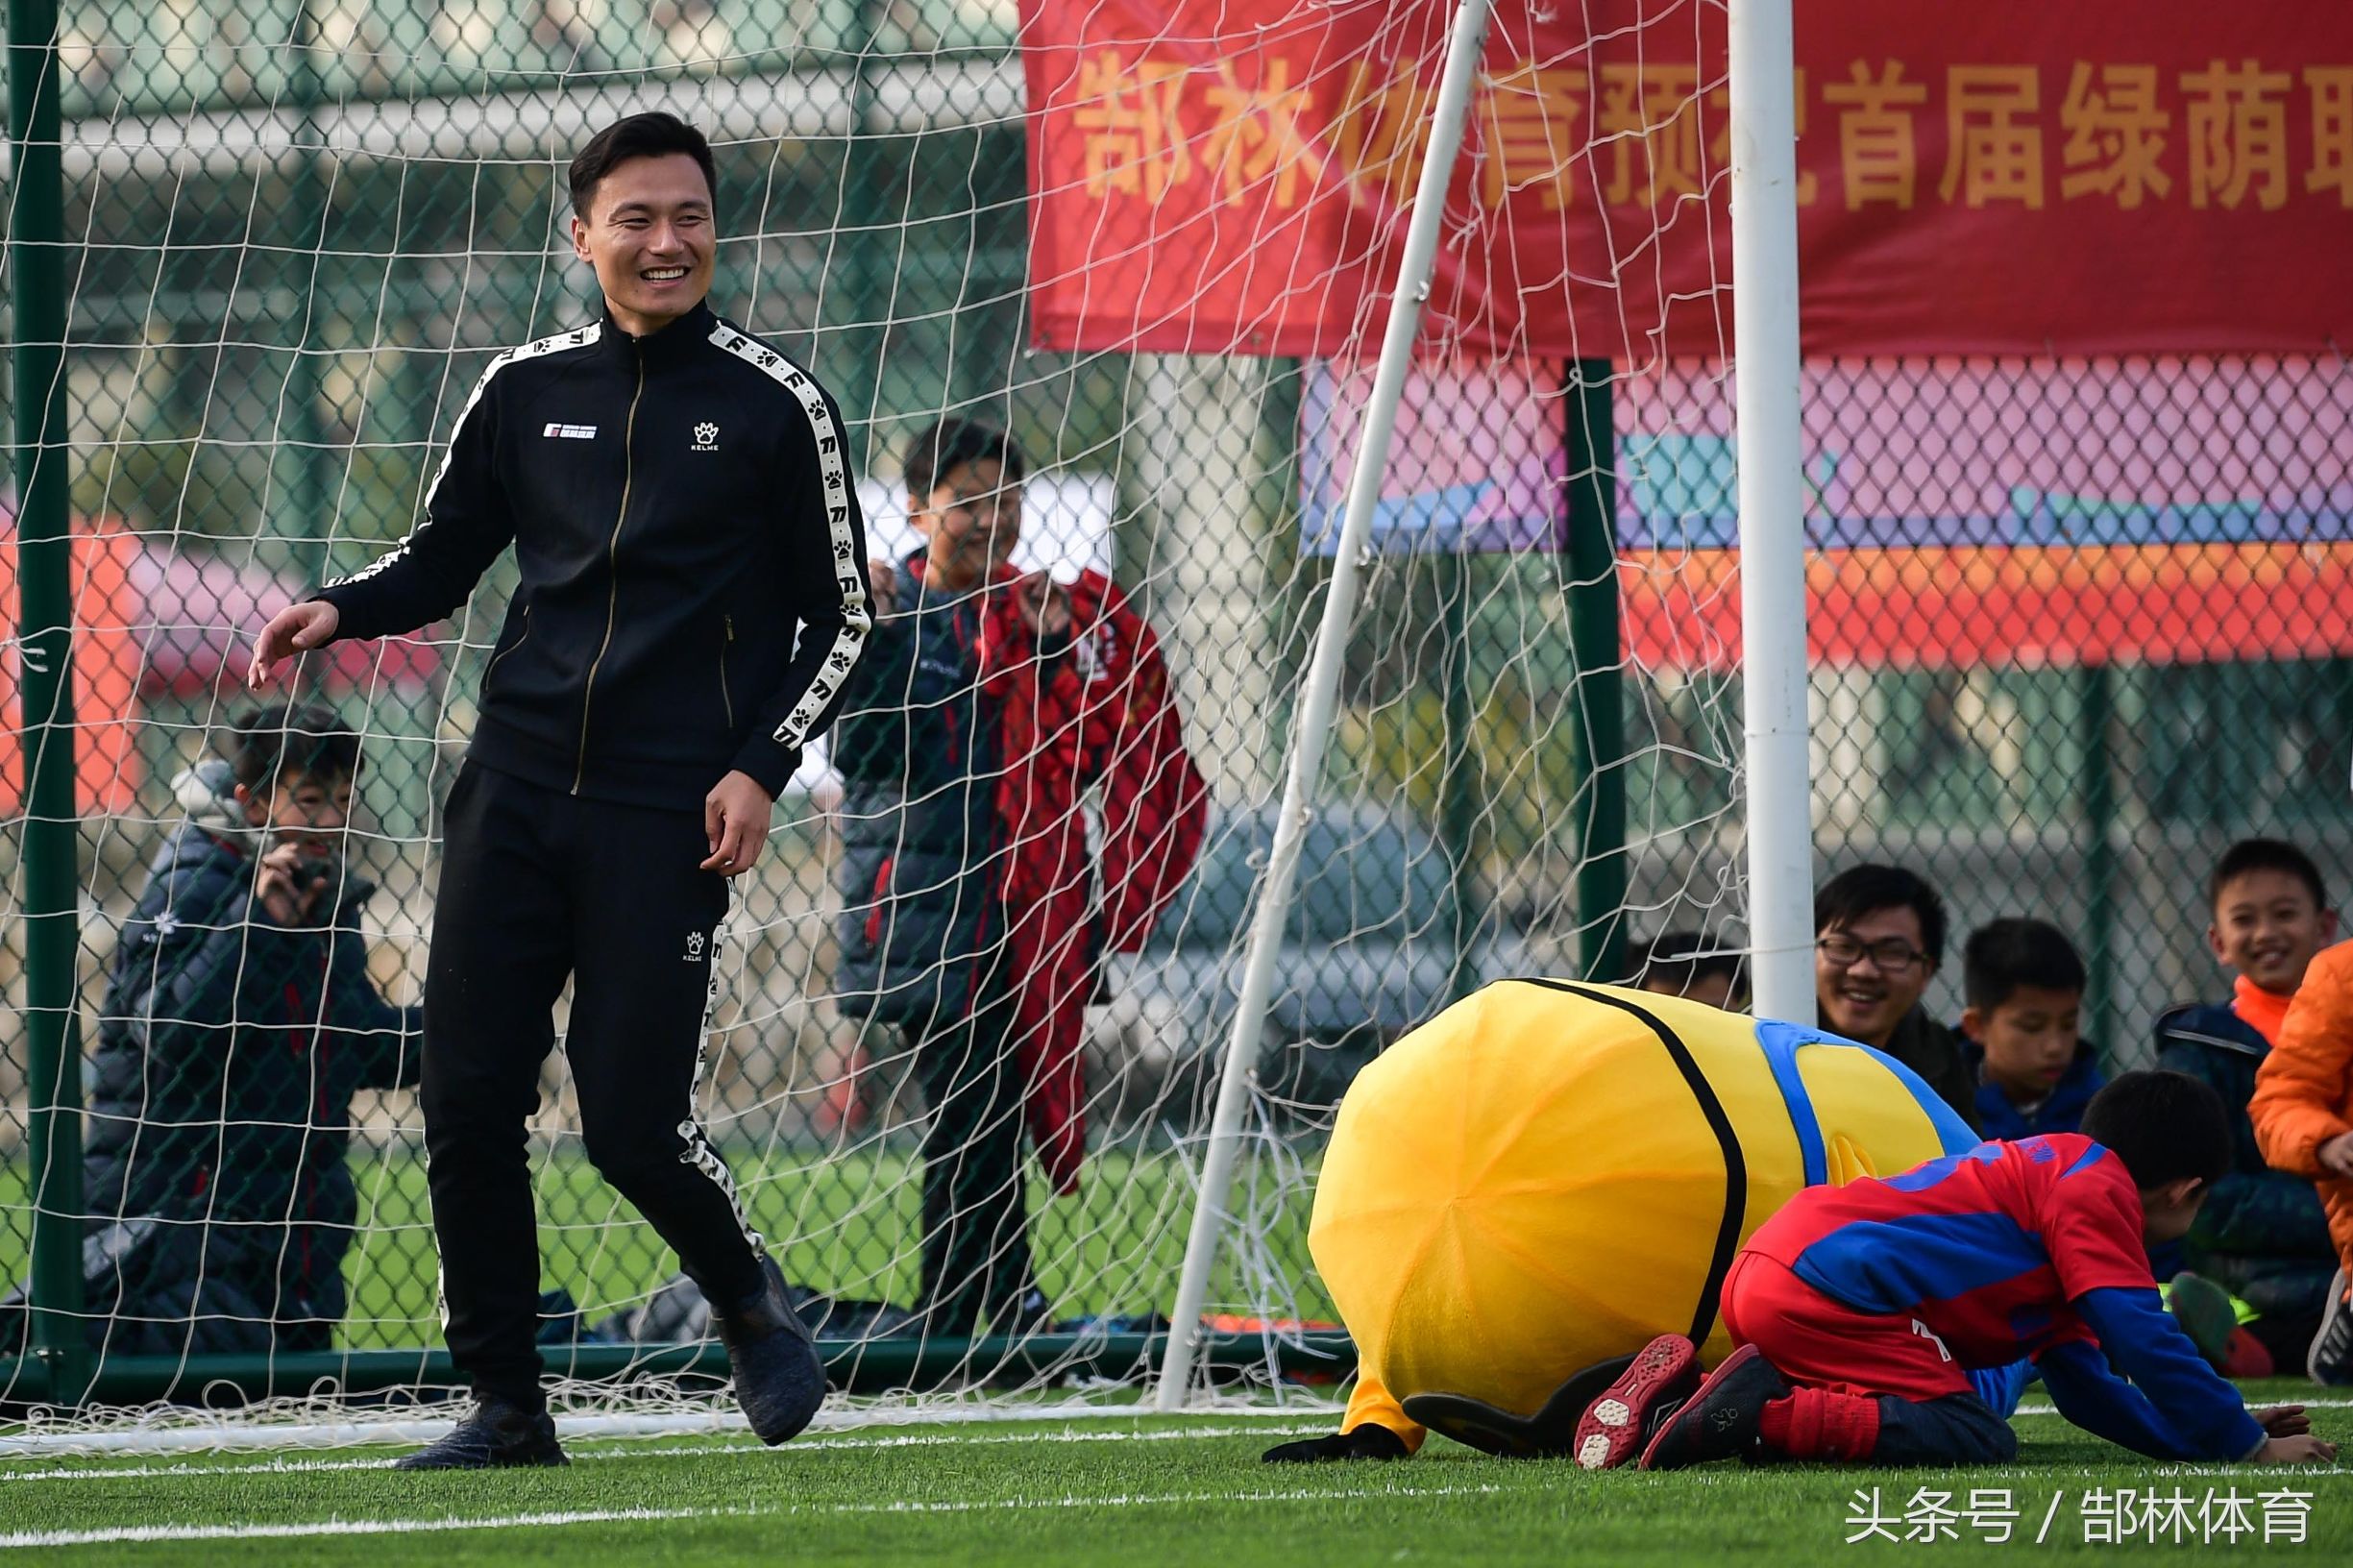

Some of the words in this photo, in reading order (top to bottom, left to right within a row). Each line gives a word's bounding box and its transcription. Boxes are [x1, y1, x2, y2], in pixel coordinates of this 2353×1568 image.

[1072, 49, 2353, 211] 郜林体育预首届绿荫
